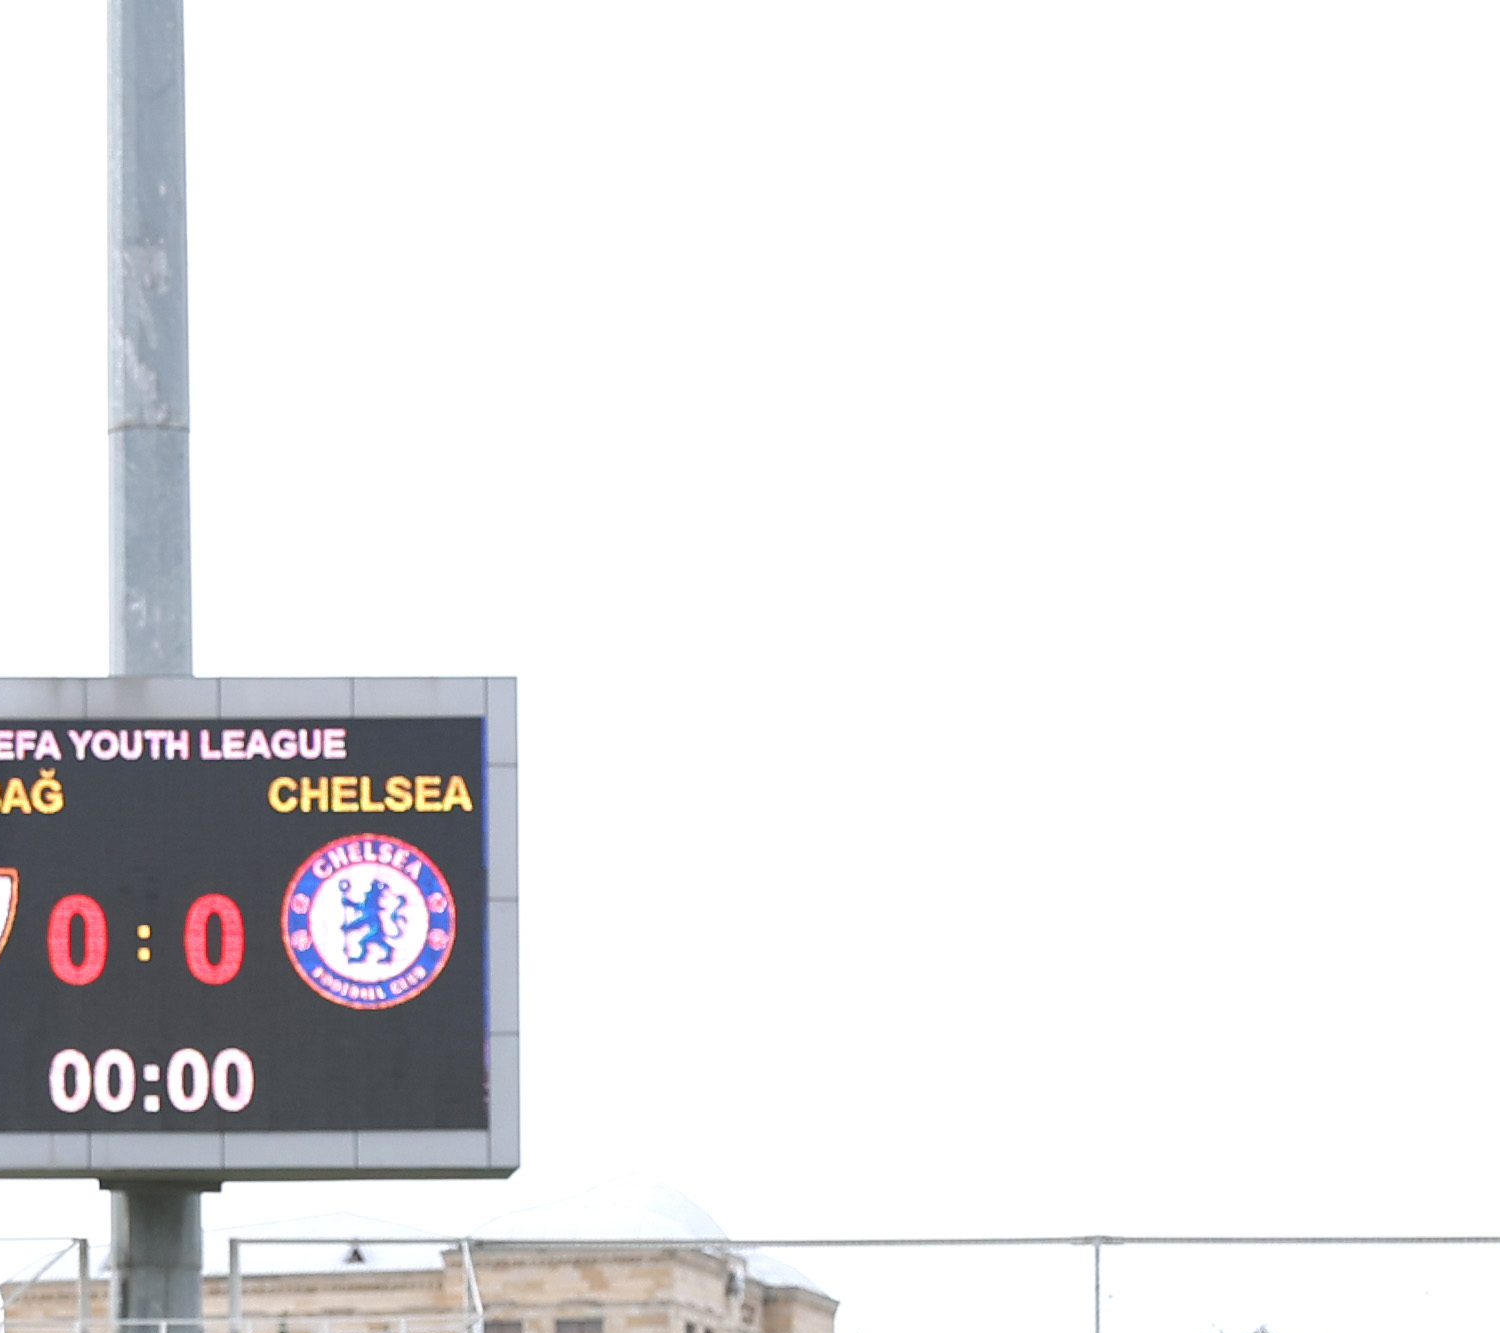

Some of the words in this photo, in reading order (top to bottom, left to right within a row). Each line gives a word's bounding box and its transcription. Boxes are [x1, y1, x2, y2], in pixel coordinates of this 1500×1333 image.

[69, 730, 190, 761] YOUTH
[201, 729, 346, 760] LEAGUE
[268, 776, 472, 813] CHELSEA
[312, 841, 423, 881] CHELSEA
[47, 894, 108, 986] 0
[184, 894, 245, 986] 0
[49, 1048, 255, 1113] 00:00
